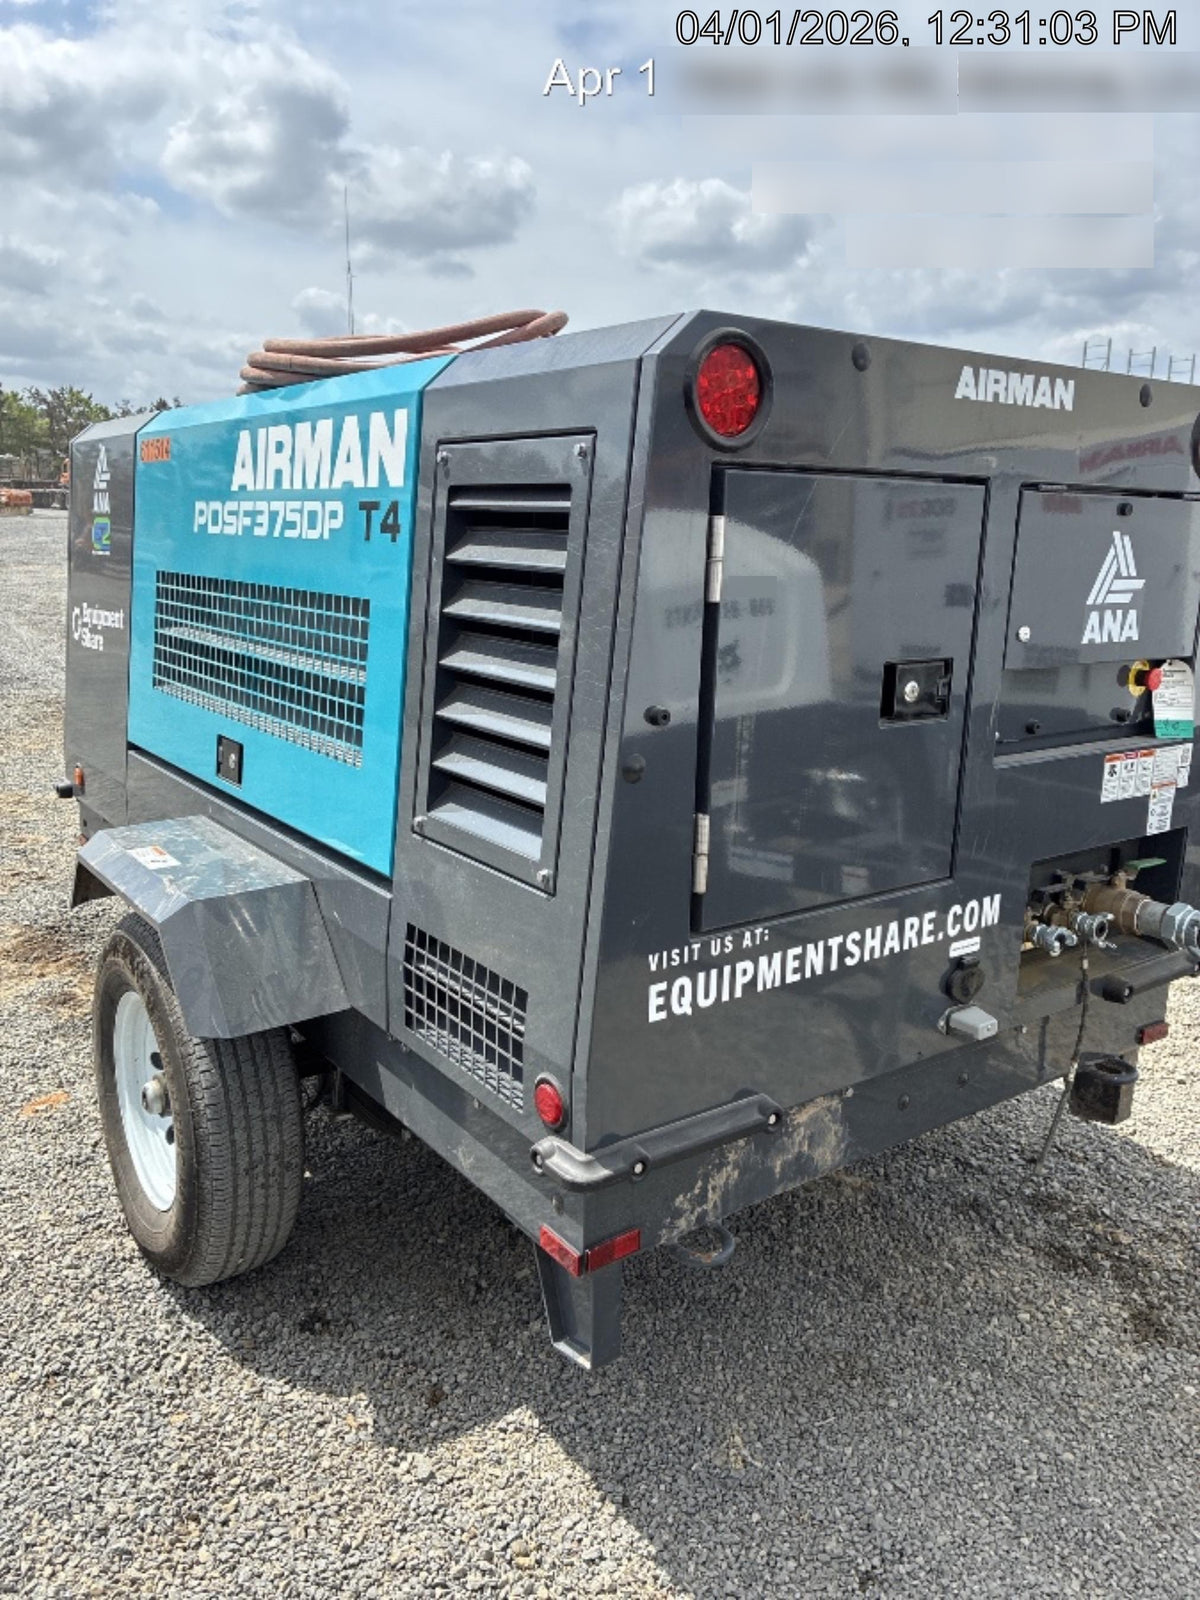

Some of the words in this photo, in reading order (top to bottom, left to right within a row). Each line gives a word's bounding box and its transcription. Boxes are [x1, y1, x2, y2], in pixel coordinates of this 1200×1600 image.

[954, 366, 1075, 411] AIRMAN
[231, 409, 408, 491] AIRMAN
[193, 500, 344, 540] PDSF375DP
[358, 500, 401, 543] T4
[82, 602, 124, 630] Equipment
[1081, 609, 1139, 645] ANA
[81, 627, 104, 651] Share
[648, 943, 701, 972] VISIT
[710, 934, 734, 957] US
[743, 928, 770, 948] AT:
[648, 894, 1001, 1023] EQUIPMENTSHARE.COM
